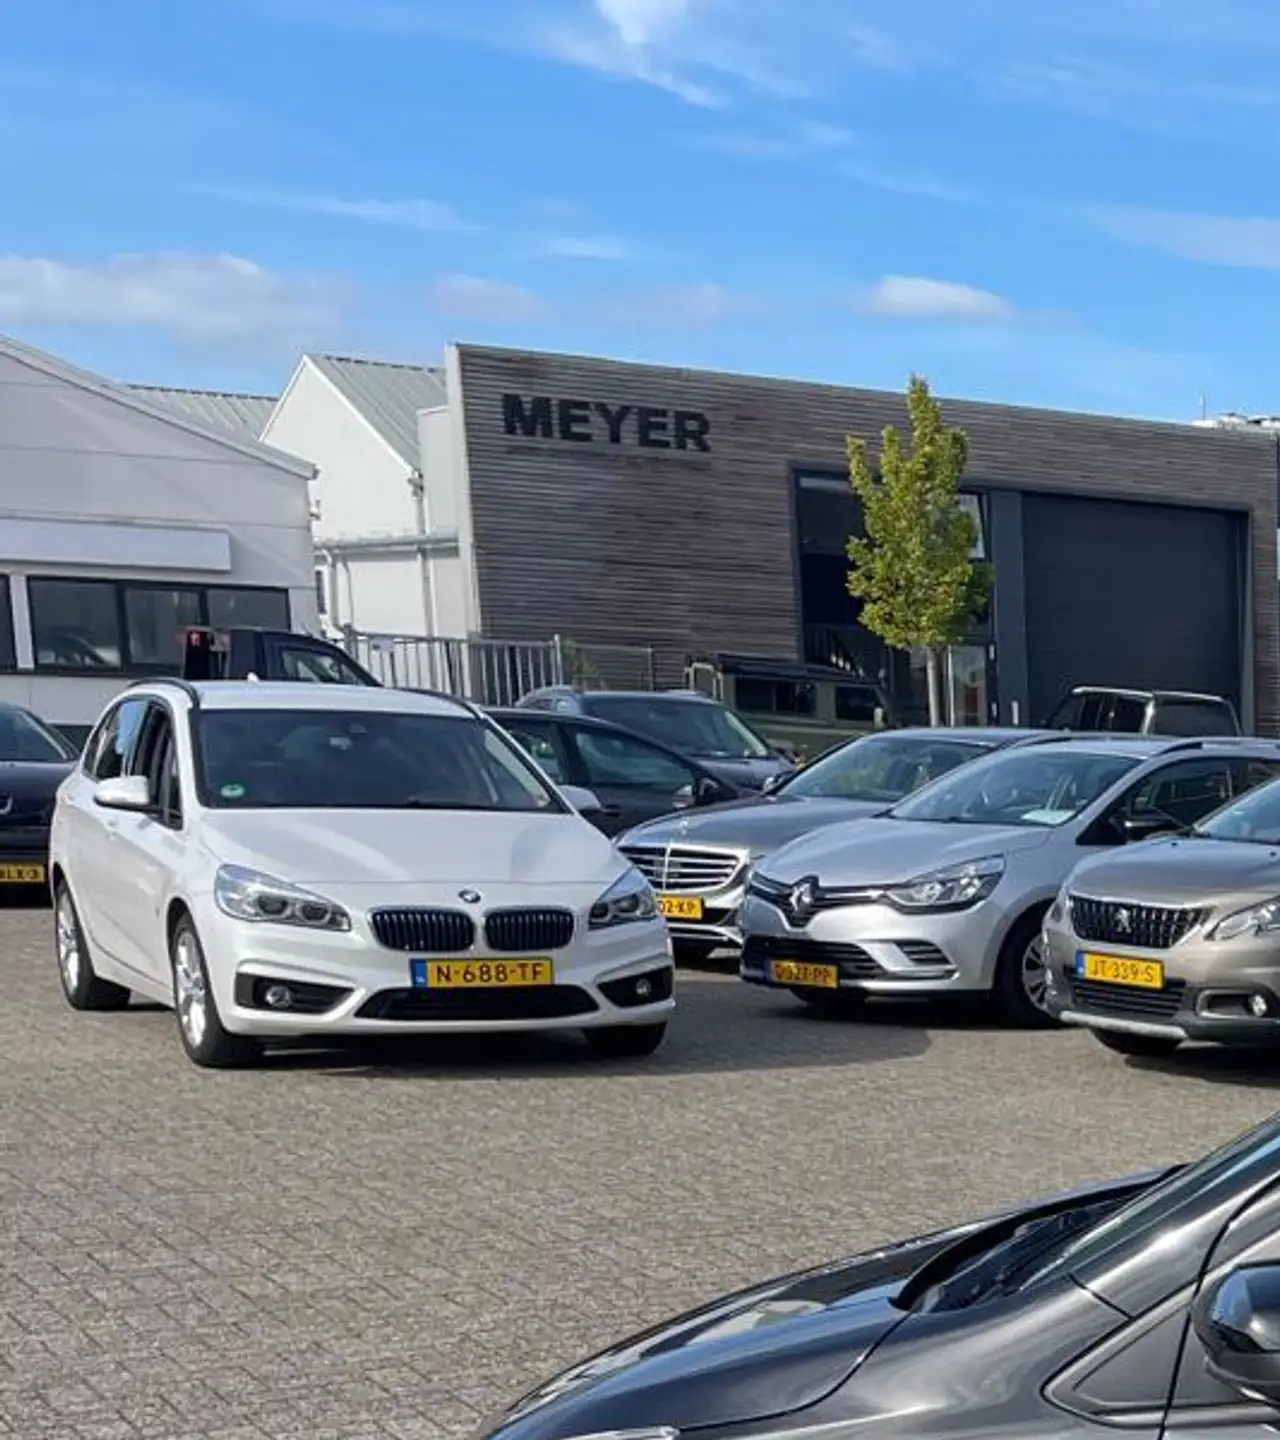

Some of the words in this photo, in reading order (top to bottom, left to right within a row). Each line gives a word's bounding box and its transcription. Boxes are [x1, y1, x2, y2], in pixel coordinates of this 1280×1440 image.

[502, 393, 712, 452] MEYER
[436, 962, 545, 983] N-688-TF
[1092, 959, 1155, 983] JT-339-S
